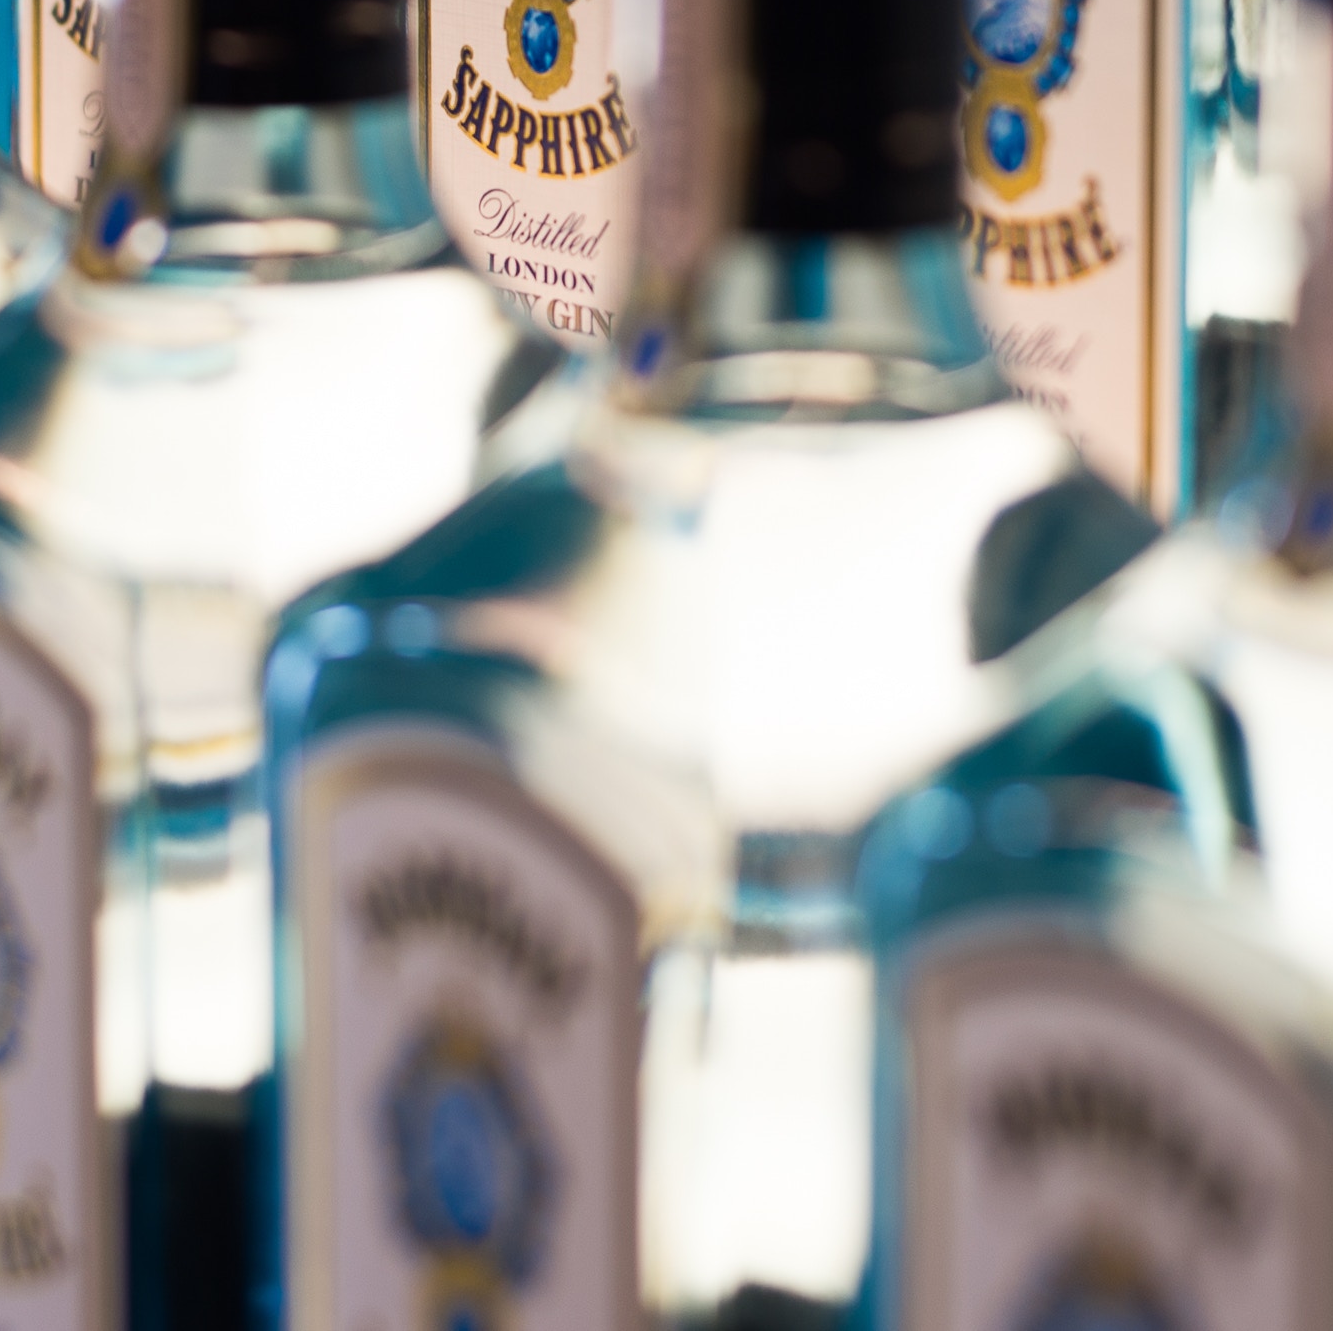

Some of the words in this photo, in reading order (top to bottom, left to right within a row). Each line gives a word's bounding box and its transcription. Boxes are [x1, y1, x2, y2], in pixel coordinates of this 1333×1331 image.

[440, 45, 640, 180] SAPPHIRE
[474, 188, 610, 261] Distilled
[959, 174, 1125, 289] PHIRE
[487, 252, 596, 294] LONDON
[546, 298, 617, 342] GIN
